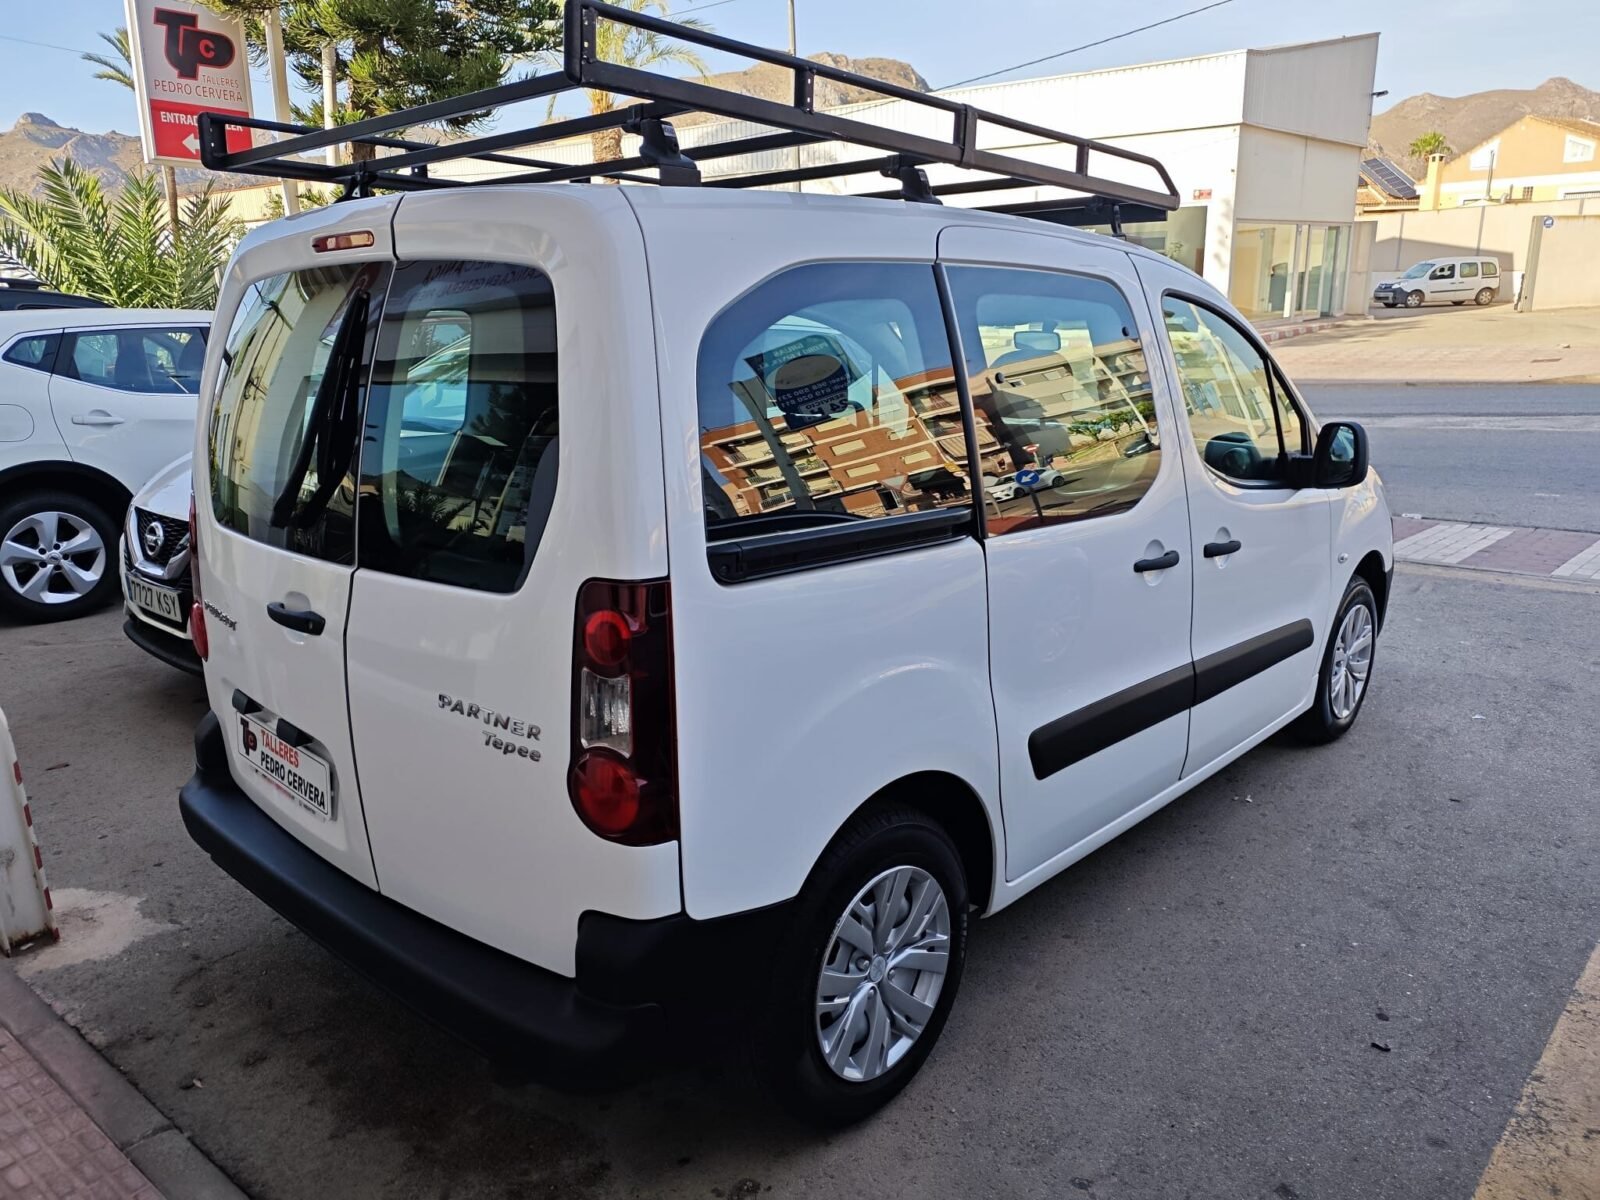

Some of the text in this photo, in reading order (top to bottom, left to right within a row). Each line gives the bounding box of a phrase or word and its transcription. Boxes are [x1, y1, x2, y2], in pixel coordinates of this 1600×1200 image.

[154, 79, 243, 102] PEDRO CERVERA
[202, 75, 239, 89] TALLERES
[160, 111, 198, 126] ENTRAD
[131, 581, 153, 610] 7727
[156, 588, 178, 618] KSY
[438, 693, 541, 741] PARTNER
[260, 729, 299, 768] TALLERES
[482, 730, 541, 762] Tepee
[260, 751, 286, 781] PEDRO
[287, 769, 326, 810] CERVERA
